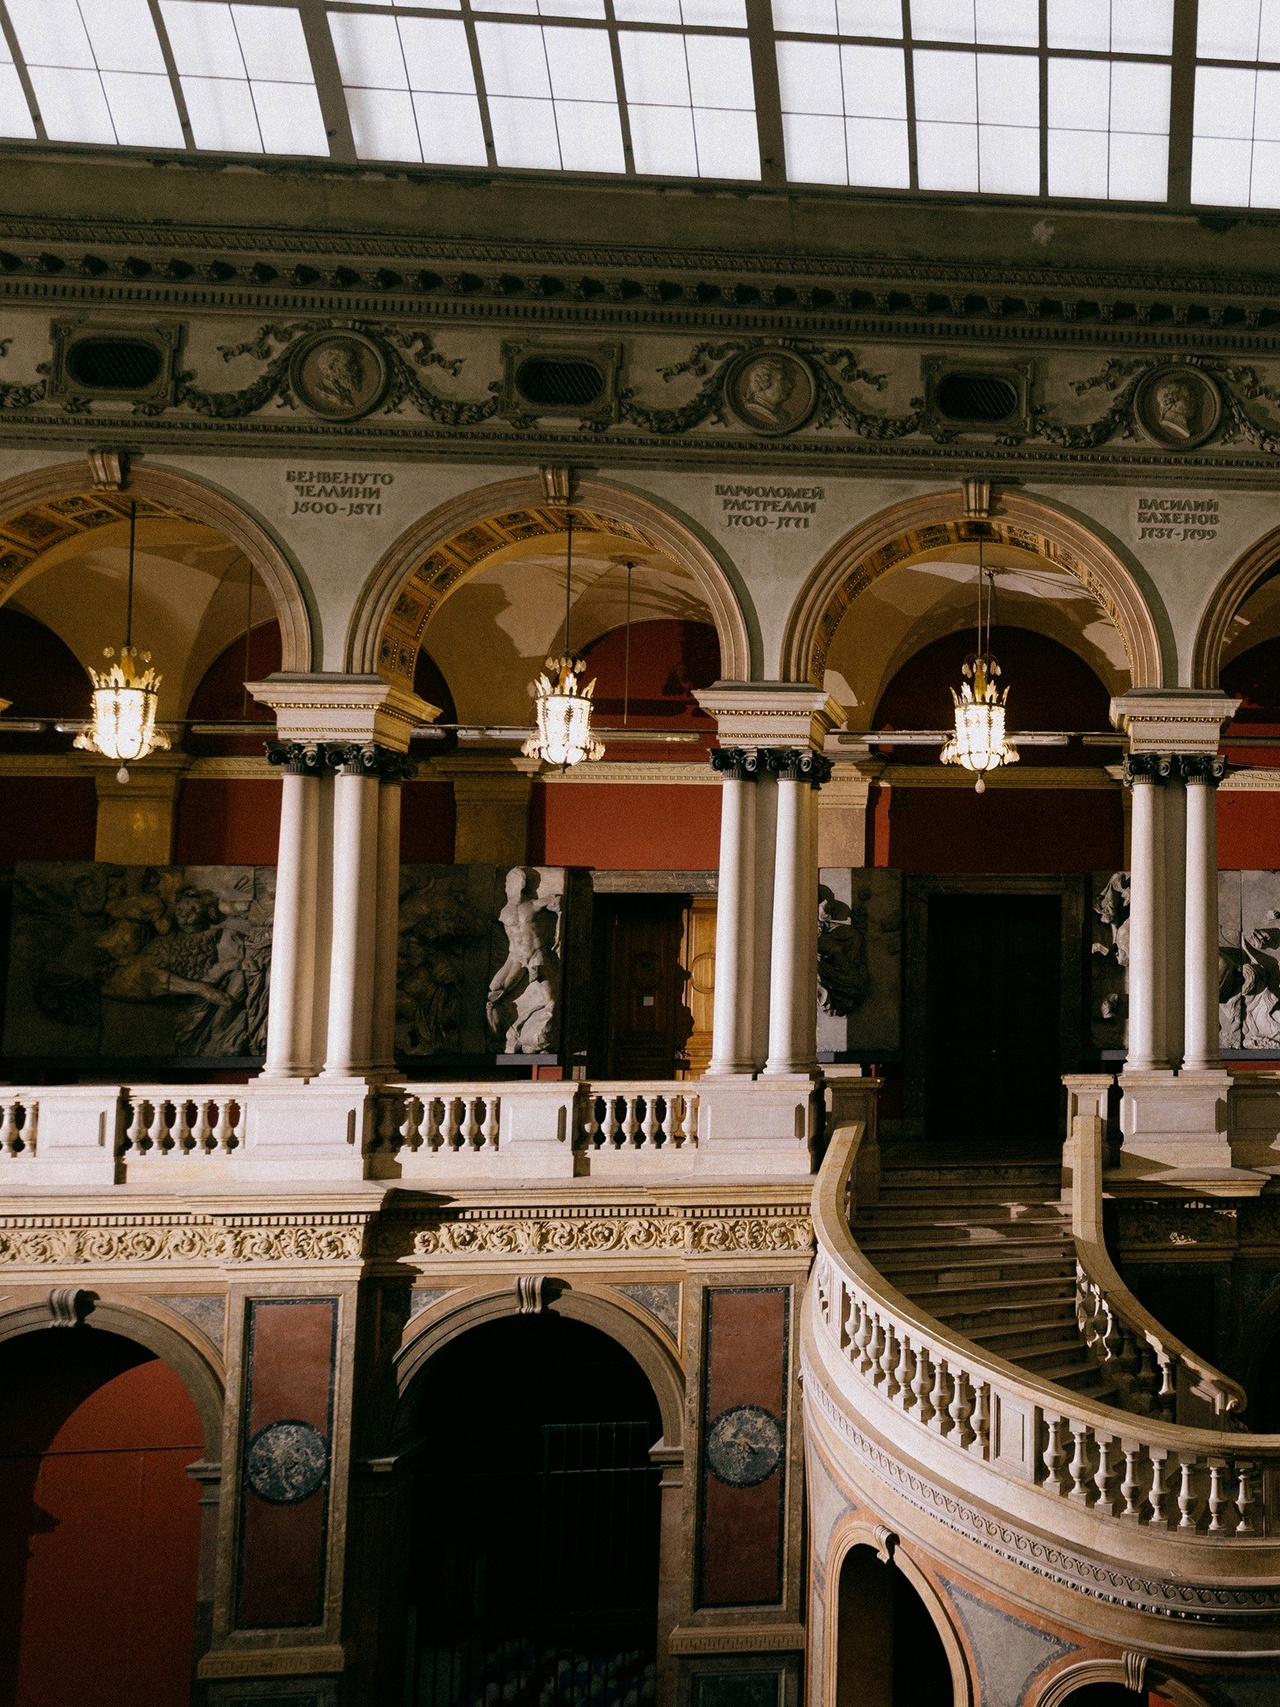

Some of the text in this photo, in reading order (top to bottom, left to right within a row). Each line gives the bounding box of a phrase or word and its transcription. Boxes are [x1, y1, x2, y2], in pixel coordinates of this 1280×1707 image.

[286, 470, 395, 486] БЕНВЕНУТО
[294, 485, 381, 500] ЧЕЛЛИНИ
[714, 484, 825, 500] ВАРФОЛОМЕЙ
[291, 501, 382, 517] 1500-1571
[722, 499, 816, 514] РАСТРЕЛЛИ
[1138, 499, 1219, 513] ВАСИЛИЙ
[726, 514, 809, 530] 1700-1771
[1137, 511, 1220, 526] БАЖЕНОВ
[1138, 527, 1218, 542] 1737-1799
